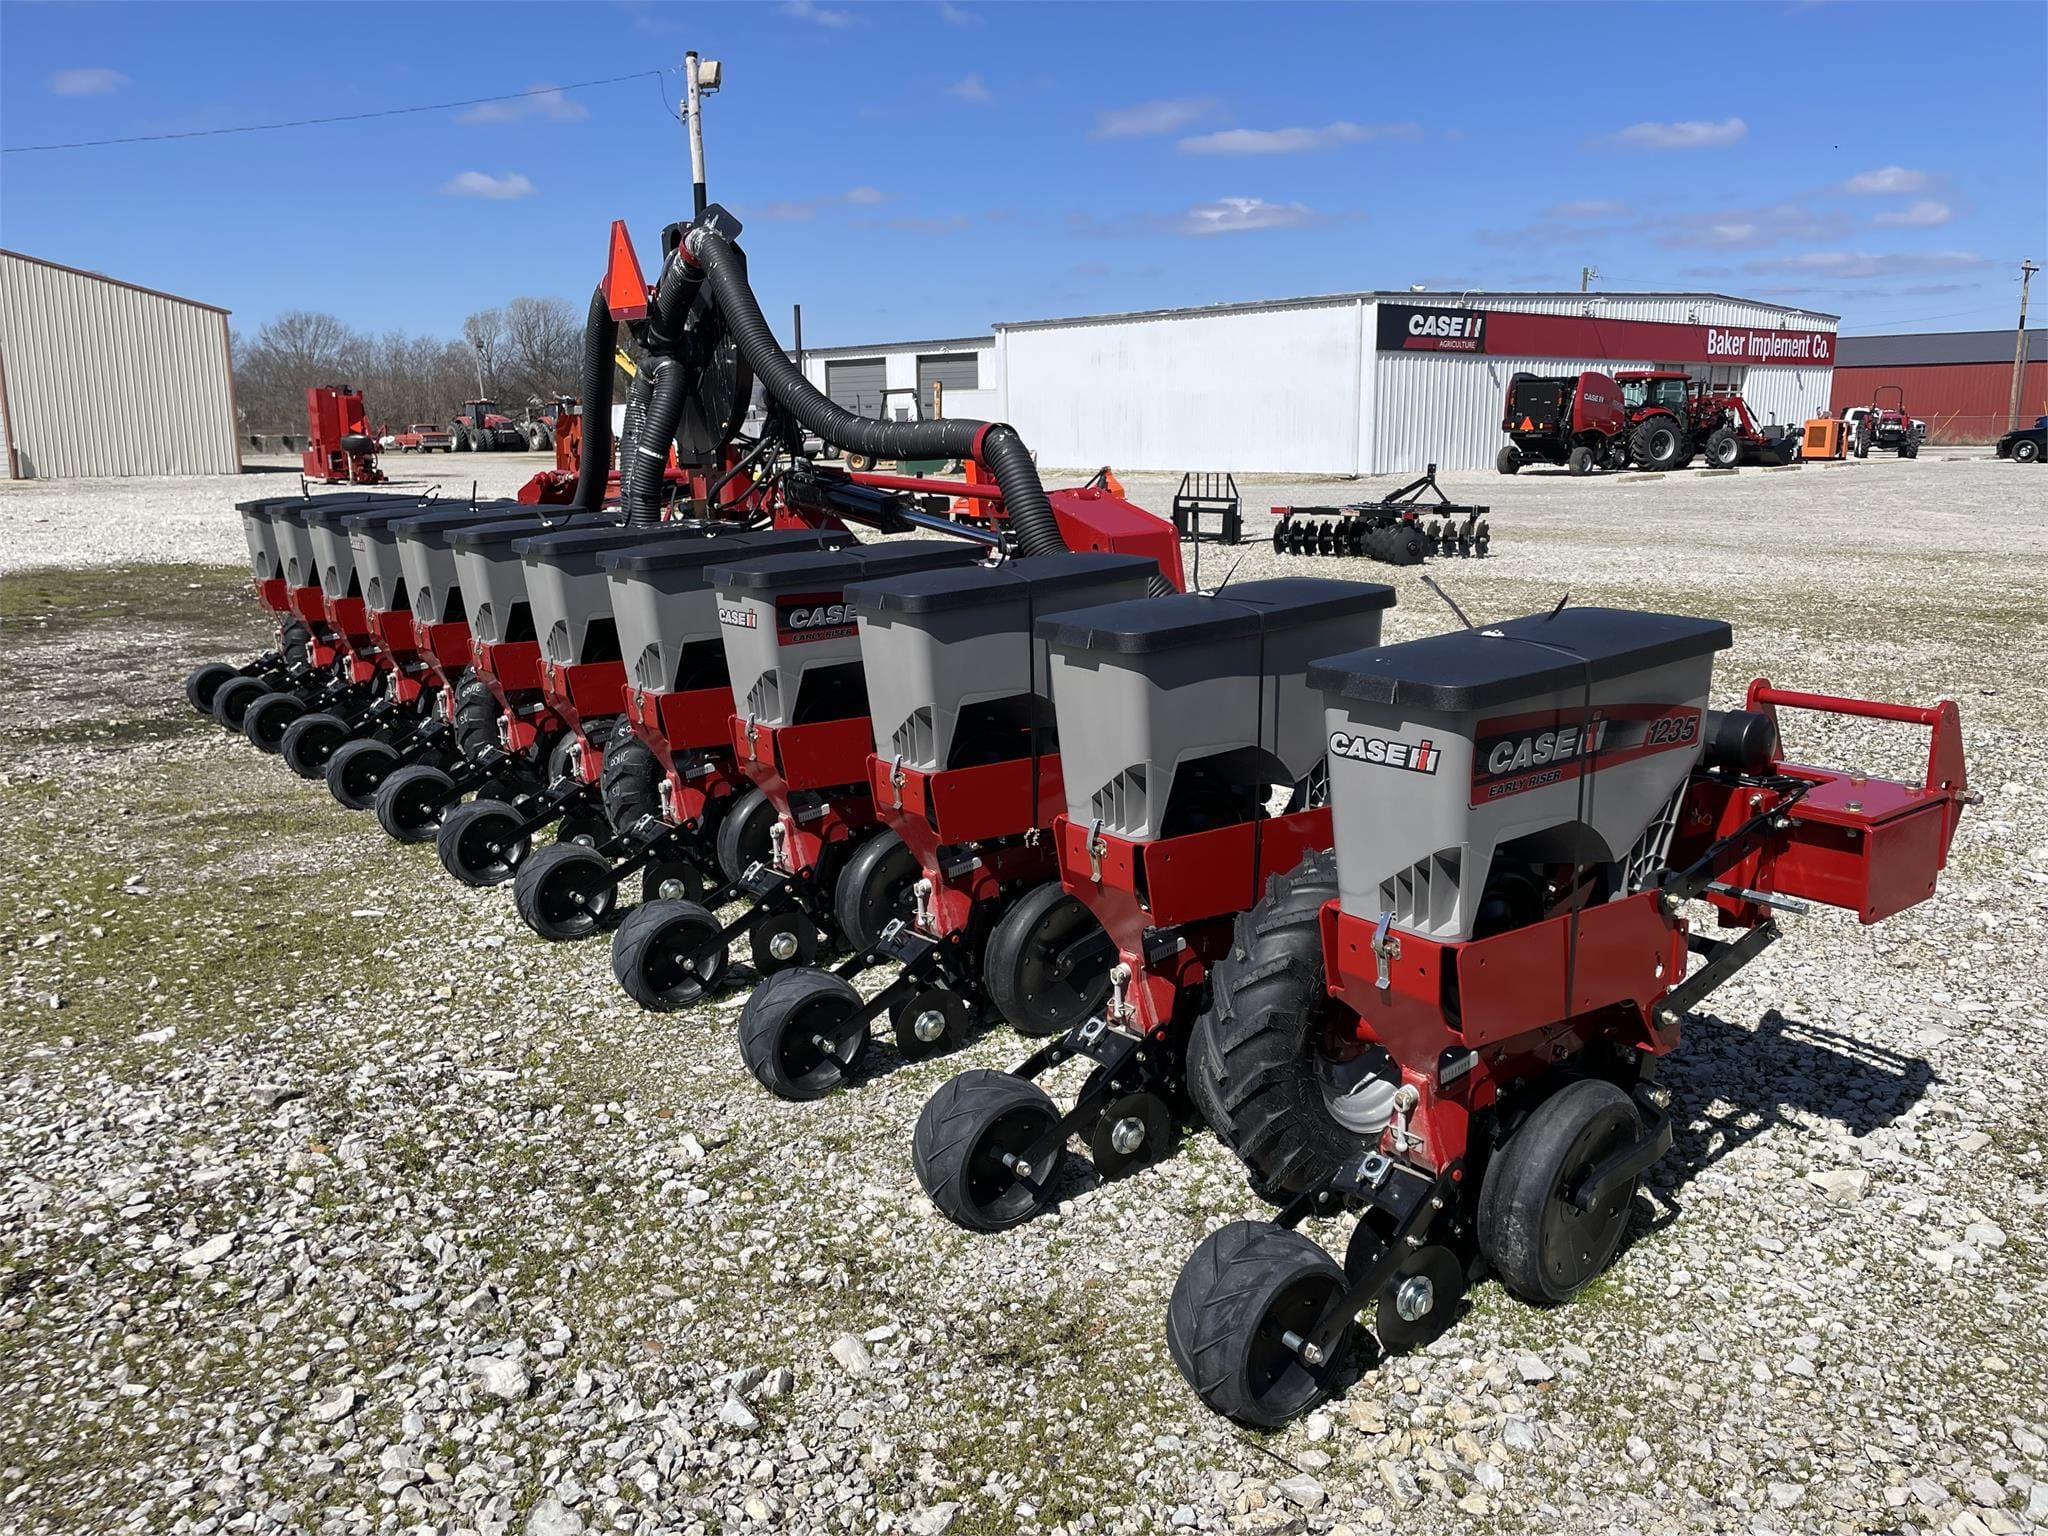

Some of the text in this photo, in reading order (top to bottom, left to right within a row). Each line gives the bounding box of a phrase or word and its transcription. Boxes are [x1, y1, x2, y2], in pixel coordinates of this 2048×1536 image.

[1409, 314, 1464, 336] CASE
[1439, 339, 1476, 349] AGRICULTURE
[1707, 329, 1829, 362] Baker Implement Co.
[719, 608, 746, 626] CASE
[789, 604, 857, 629] CASE
[1330, 732, 1408, 767] CASE
[1488, 727, 1578, 775] CASE
[1649, 715, 1698, 746] 1235
[1488, 770, 1561, 797] EARLY RISER
